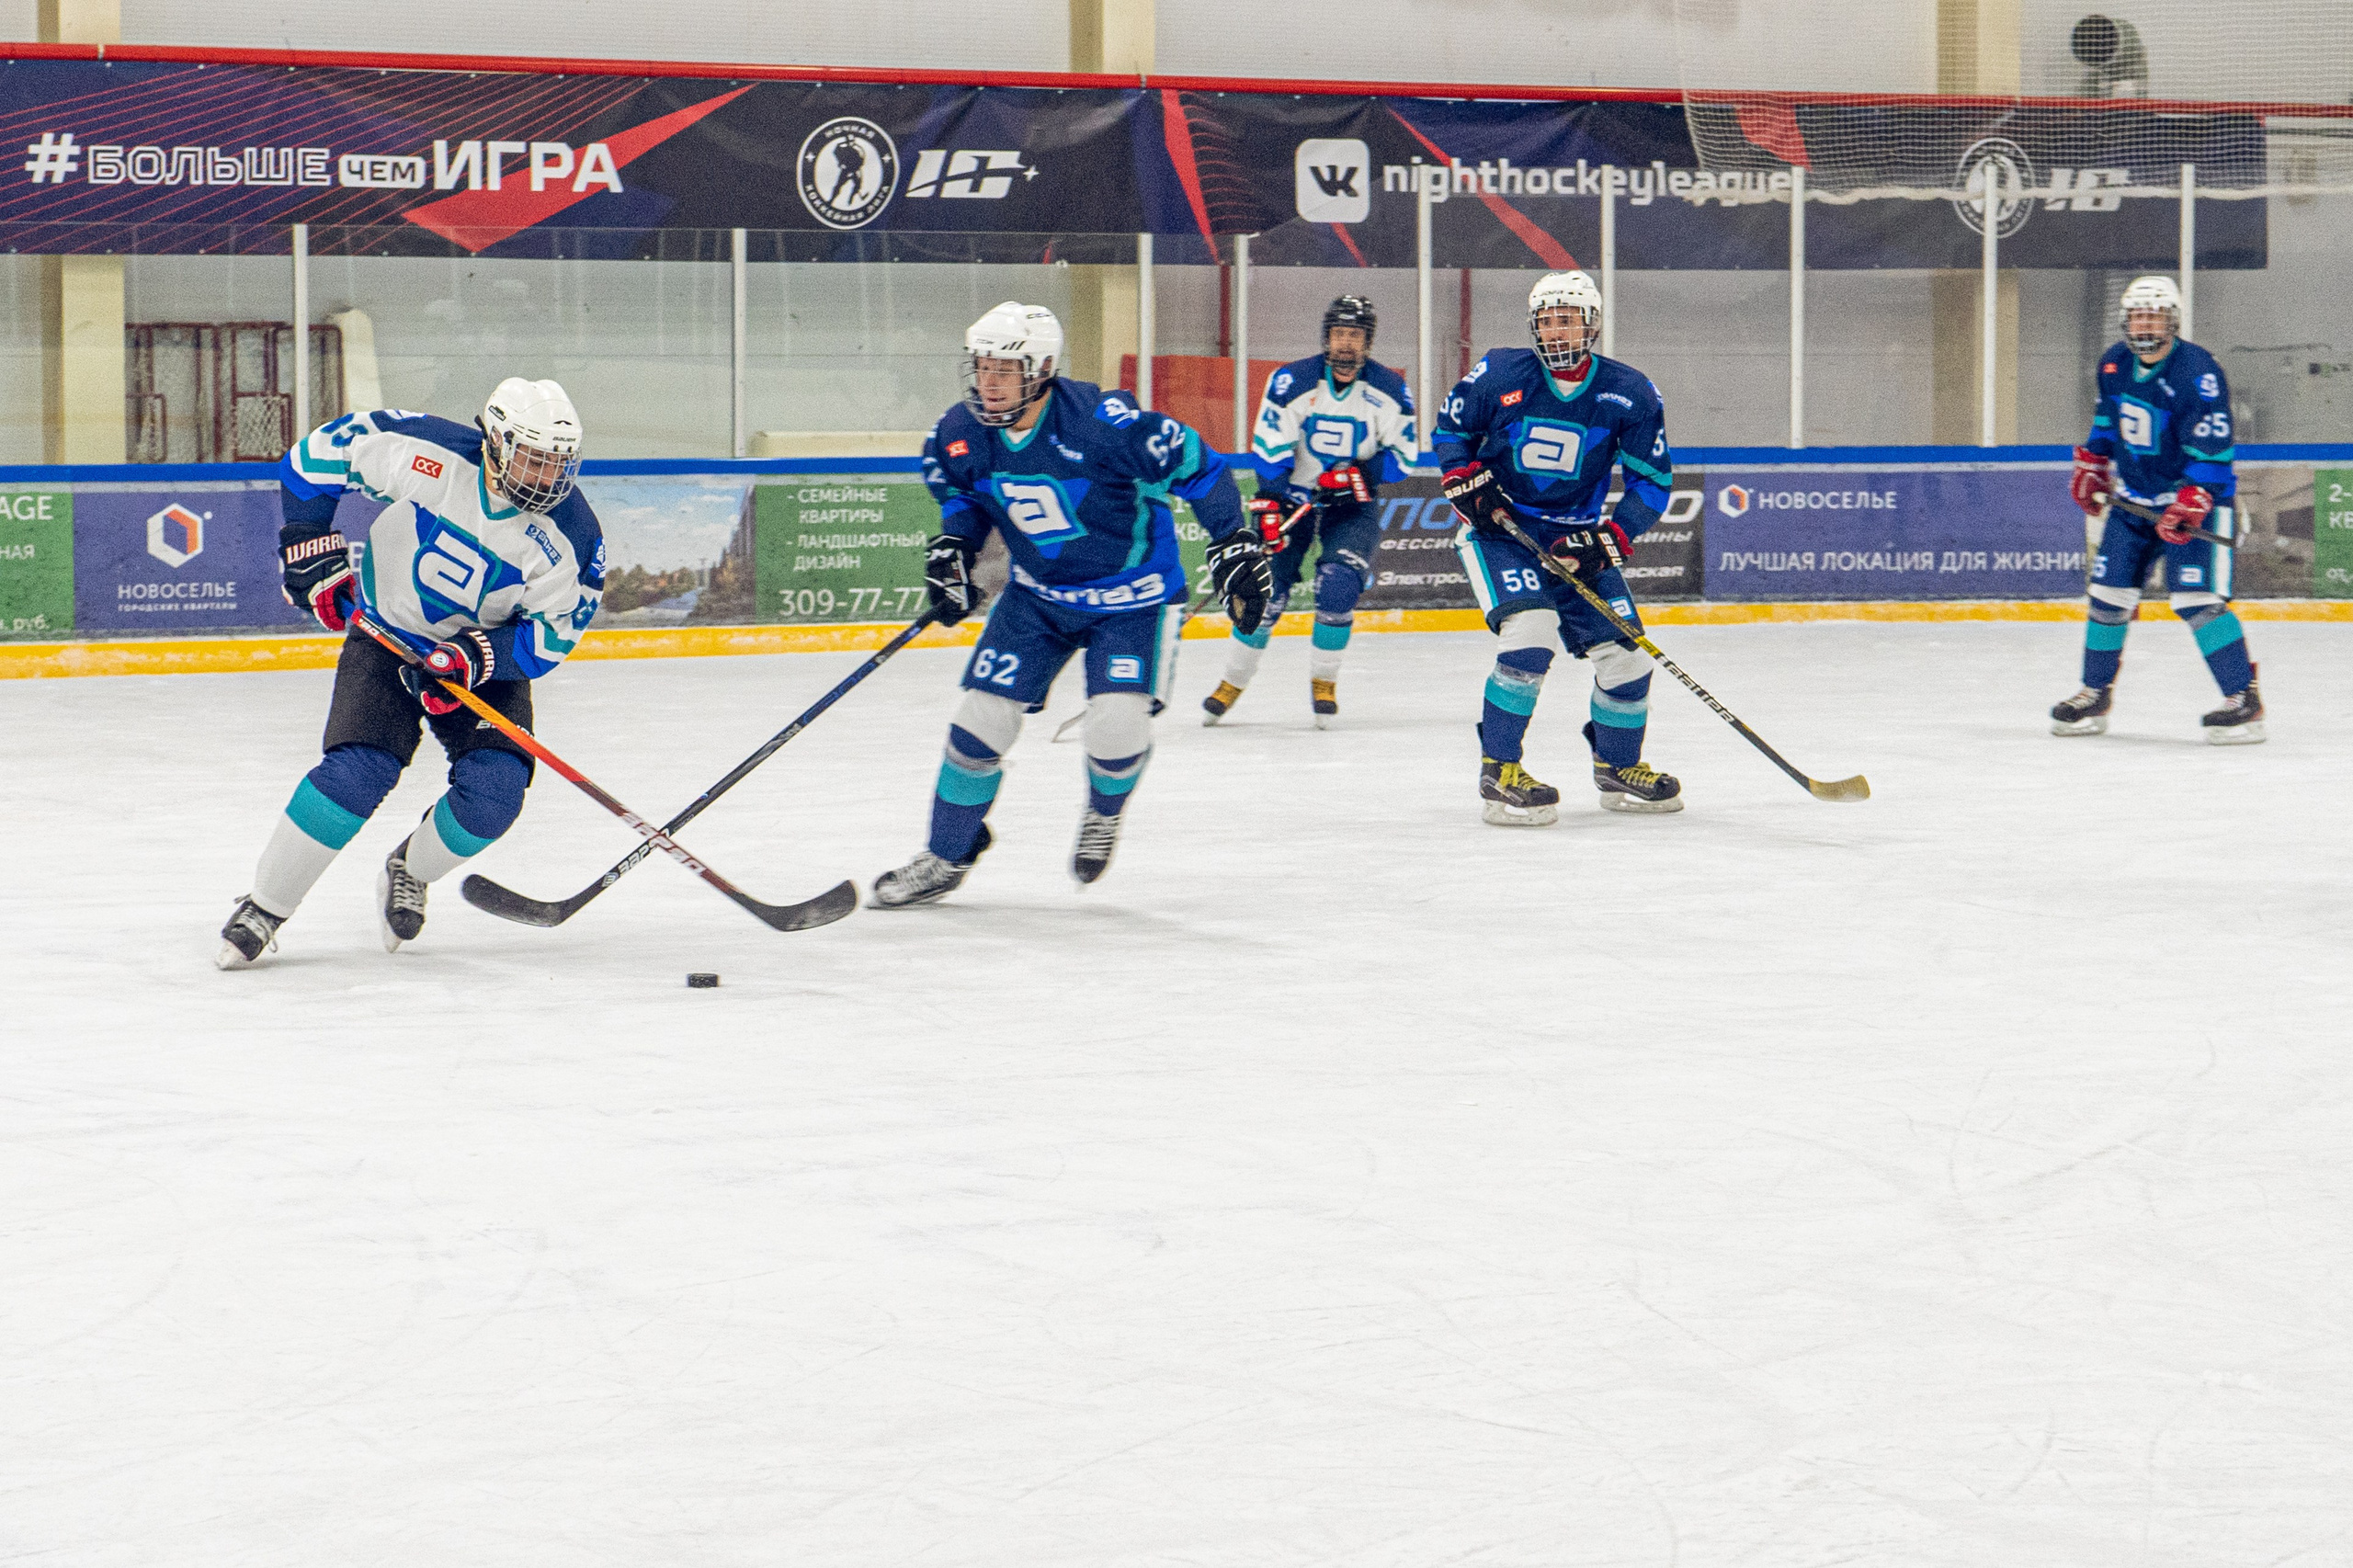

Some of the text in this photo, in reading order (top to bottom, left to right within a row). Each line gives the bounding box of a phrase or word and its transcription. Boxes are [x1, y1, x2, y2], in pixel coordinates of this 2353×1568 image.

[434, 140, 624, 193] ИГРА
[797, 486, 888, 503] СЕМЕЙНЫЕ
[1758, 491, 1898, 510] НОВОСЕЛЬЕ
[799, 508, 884, 524] КВАРТИРЫ
[798, 530, 927, 550] ЛАНДШАФТНЫЙ
[793, 553, 861, 571] ДИЗАЙН
[1719, 551, 1815, 572] ЛУЧШАЯ
[1820, 551, 1935, 574] ЛОКАЦИЯ
[1938, 551, 1988, 574] ДЛЯ
[118, 581, 237, 599] НОВОСЕЛЬЕ
[1502, 568, 1541, 592] 58
[779, 586, 928, 617] 309-77-77
[972, 648, 1021, 686] 62
